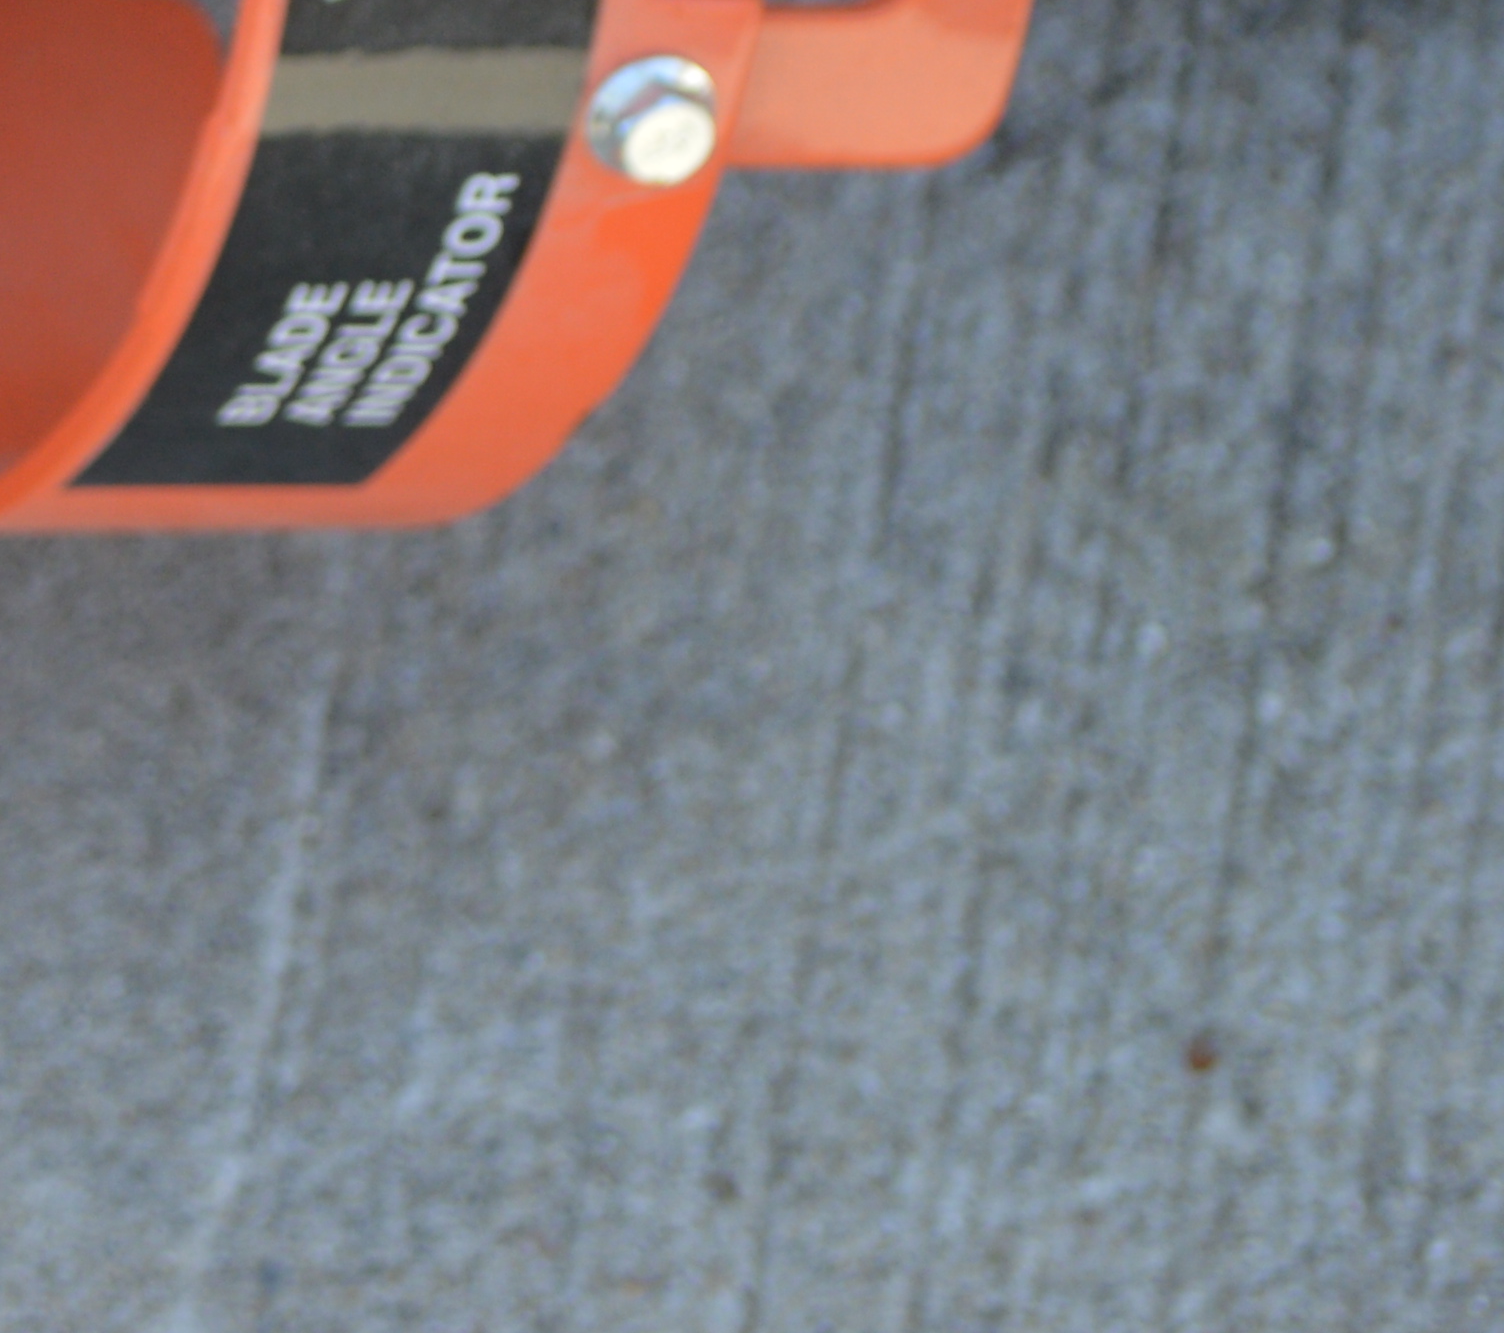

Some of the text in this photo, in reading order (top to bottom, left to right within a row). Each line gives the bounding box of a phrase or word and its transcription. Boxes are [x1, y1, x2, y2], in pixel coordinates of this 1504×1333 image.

[215, 280, 350, 427] BLADE
[284, 278, 415, 427] ANGLE
[340, 171, 521, 427] INDICATOR
